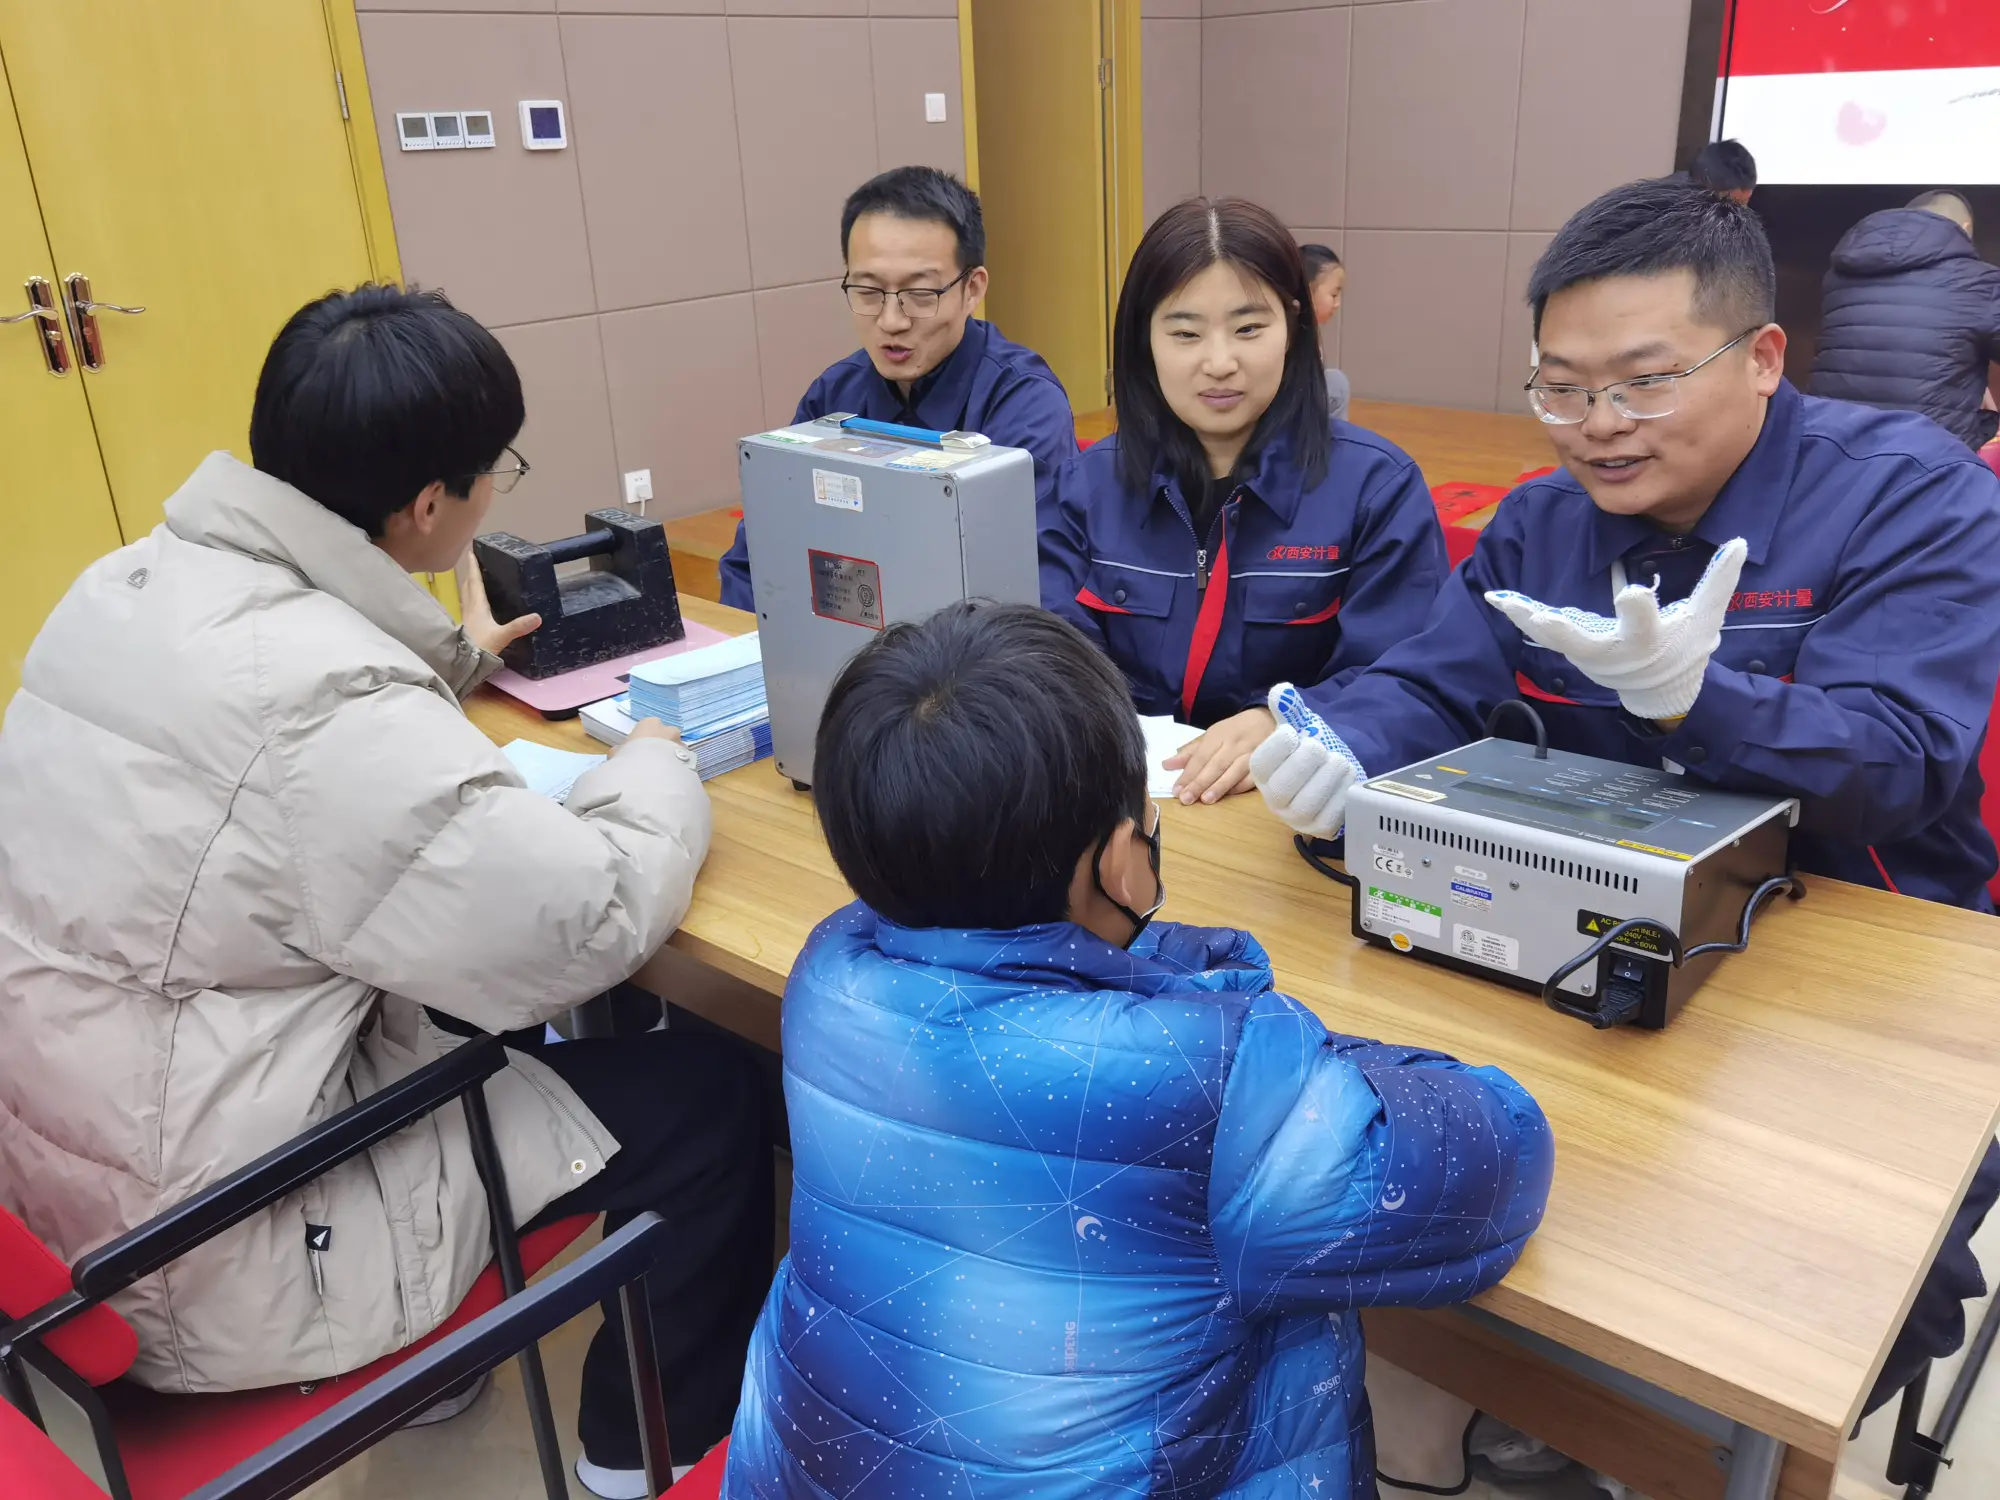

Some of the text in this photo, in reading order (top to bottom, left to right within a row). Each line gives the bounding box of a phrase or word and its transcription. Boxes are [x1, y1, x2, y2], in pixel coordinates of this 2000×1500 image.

[1287, 545, 1340, 560] 西安计量
[1743, 588, 1813, 609] 西安计量
[1375, 856, 1393, 873] CE
[1455, 885, 1489, 898] CALIBRATED
[1601, 917, 1612, 925] AC
